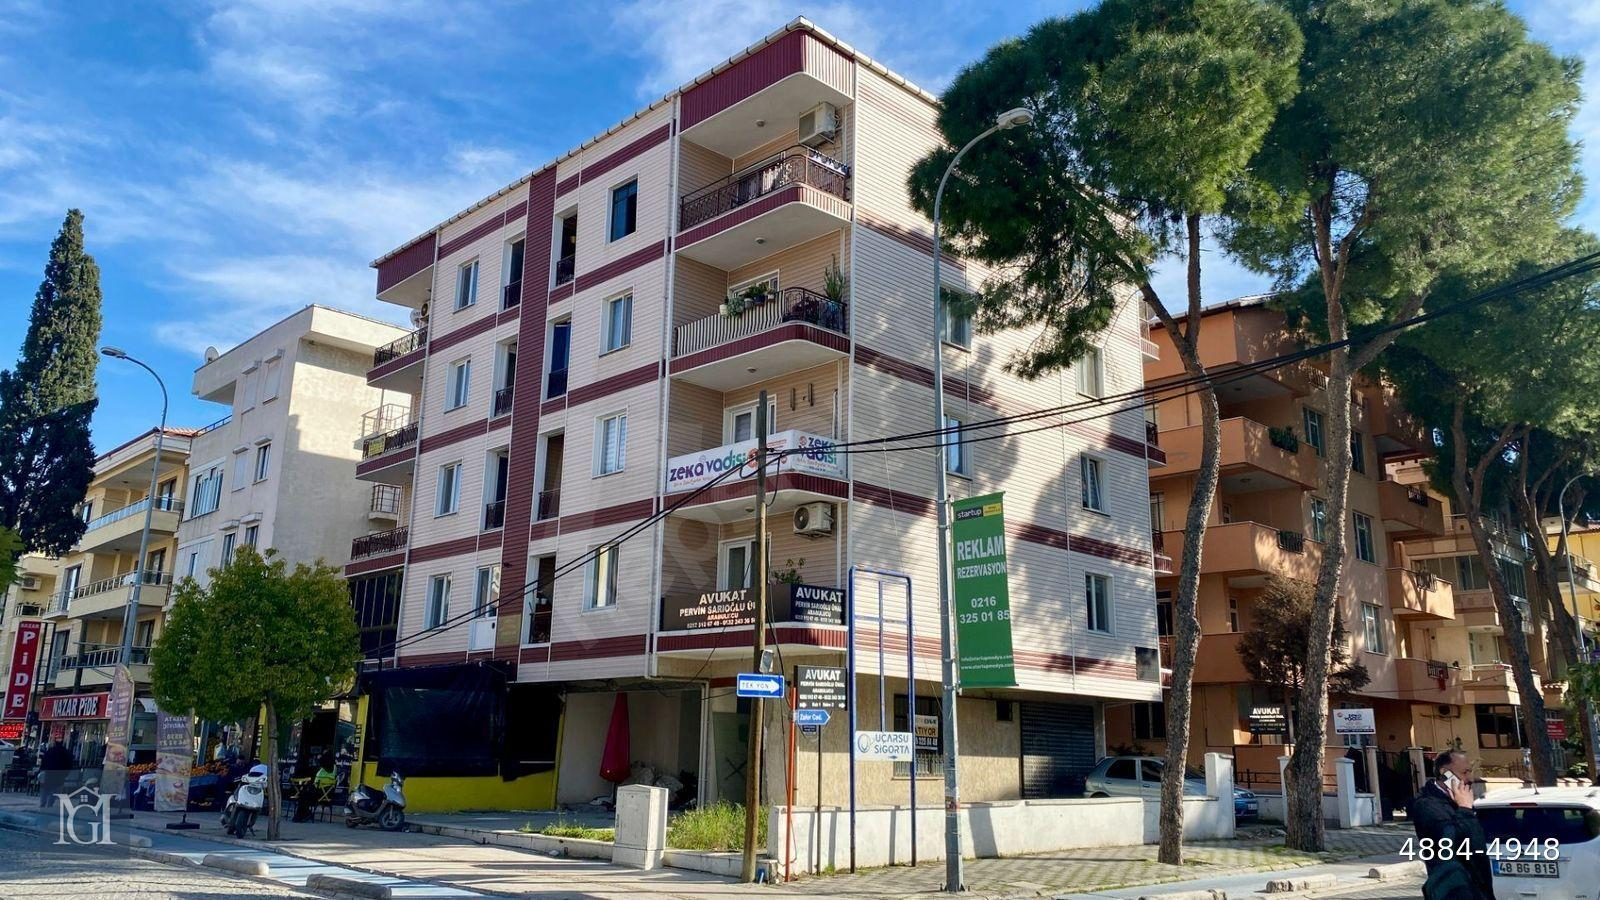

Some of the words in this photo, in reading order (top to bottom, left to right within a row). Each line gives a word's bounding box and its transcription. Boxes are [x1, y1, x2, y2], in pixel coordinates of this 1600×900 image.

[669, 460, 704, 482] zeka
[956, 508, 982, 518] startup
[956, 534, 1004, 562] REKLAM
[956, 561, 1006, 580] REZERVASYON
[699, 590, 747, 606] AVUKAT
[796, 586, 843, 603] AVUKAT
[971, 596, 997, 608] 0216
[707, 602, 746, 615] SARIOĞLU
[960, 612, 978, 624] 325
[982, 611, 993, 622] 01
[997, 609, 1010, 621] 85
[805, 669, 841, 681] AVUKAT
[52, 698, 78, 717] NAZAR
[875, 733, 909, 744] UÇARSU
[1500, 863, 1512, 872] 48
[1516, 863, 1530, 873] BG
[1535, 864, 1556, 874] 815
